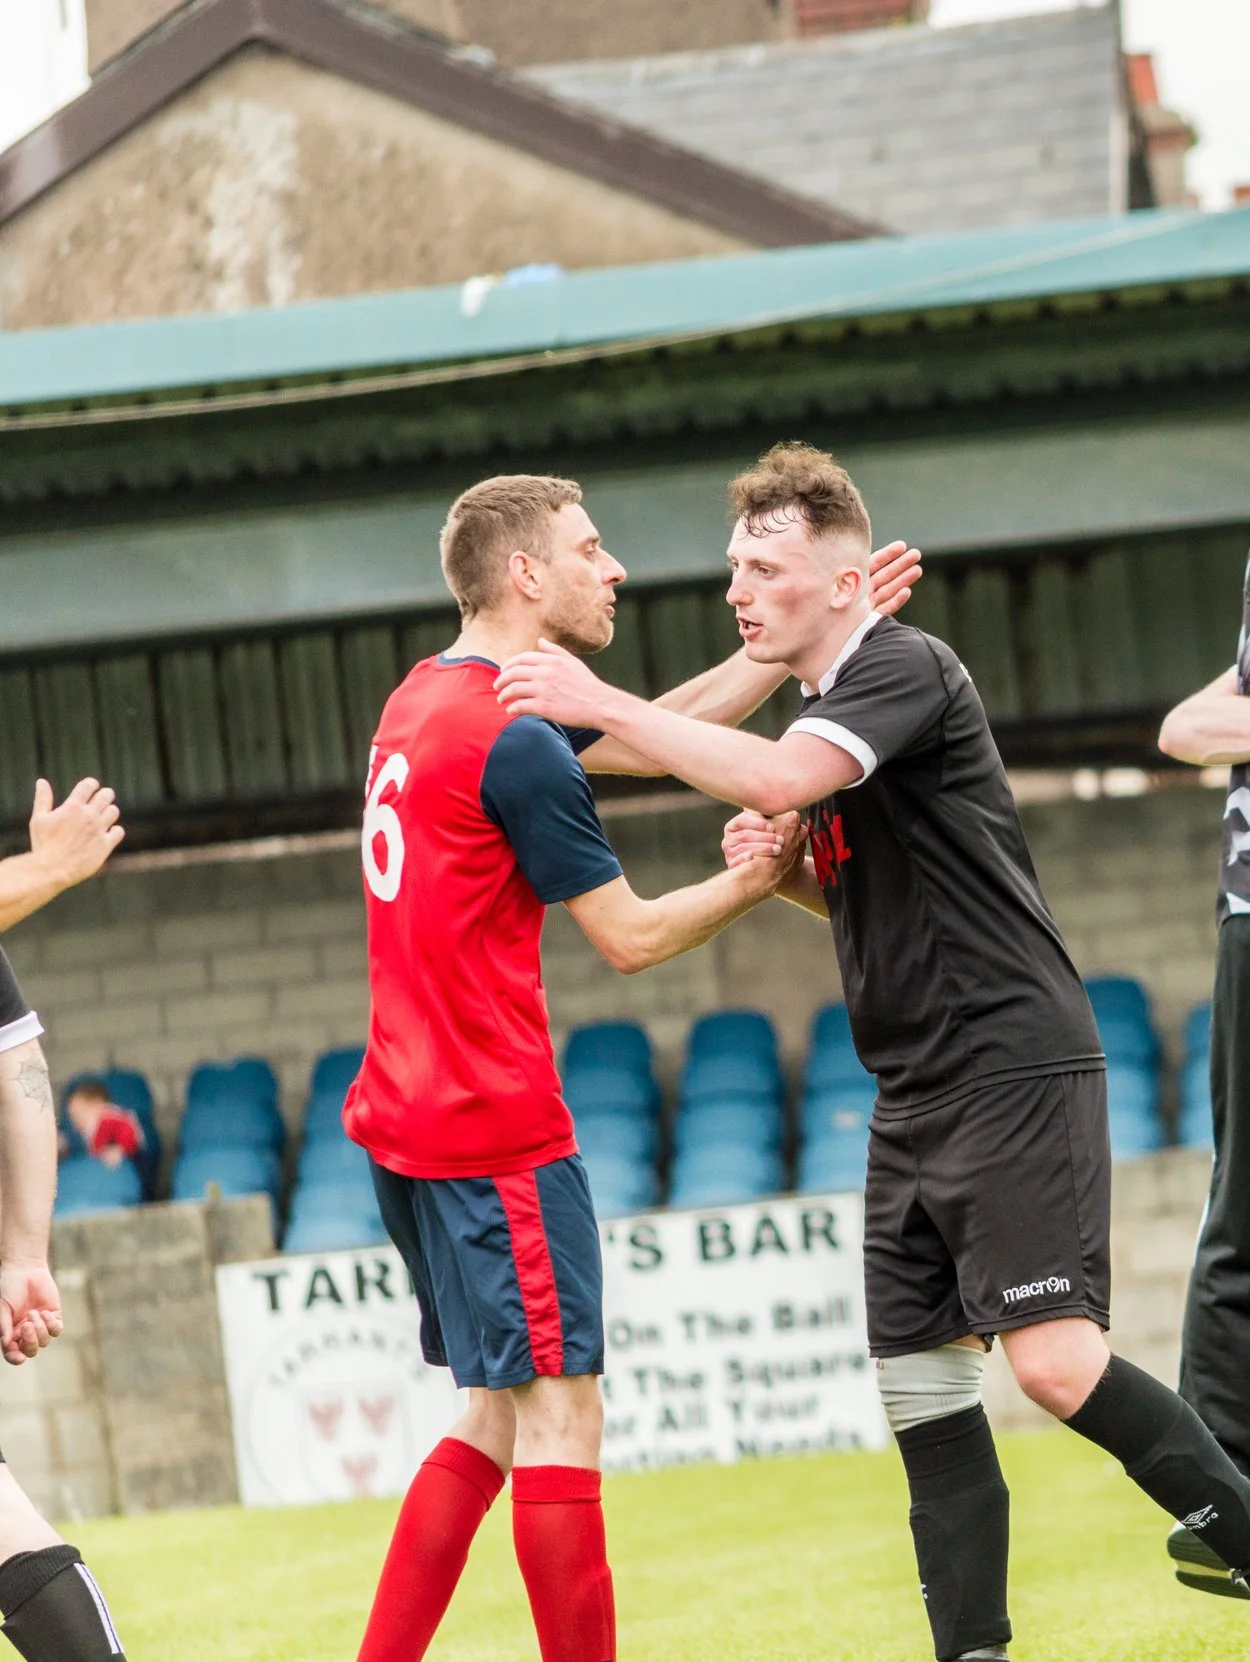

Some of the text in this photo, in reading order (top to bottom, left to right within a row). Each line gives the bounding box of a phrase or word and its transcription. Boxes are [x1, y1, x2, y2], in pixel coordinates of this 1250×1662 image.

[361, 744, 410, 902] 6
[696, 1206, 838, 1265] BAR
[1002, 1276, 1070, 1303] macron
[679, 1310, 752, 1342] The
